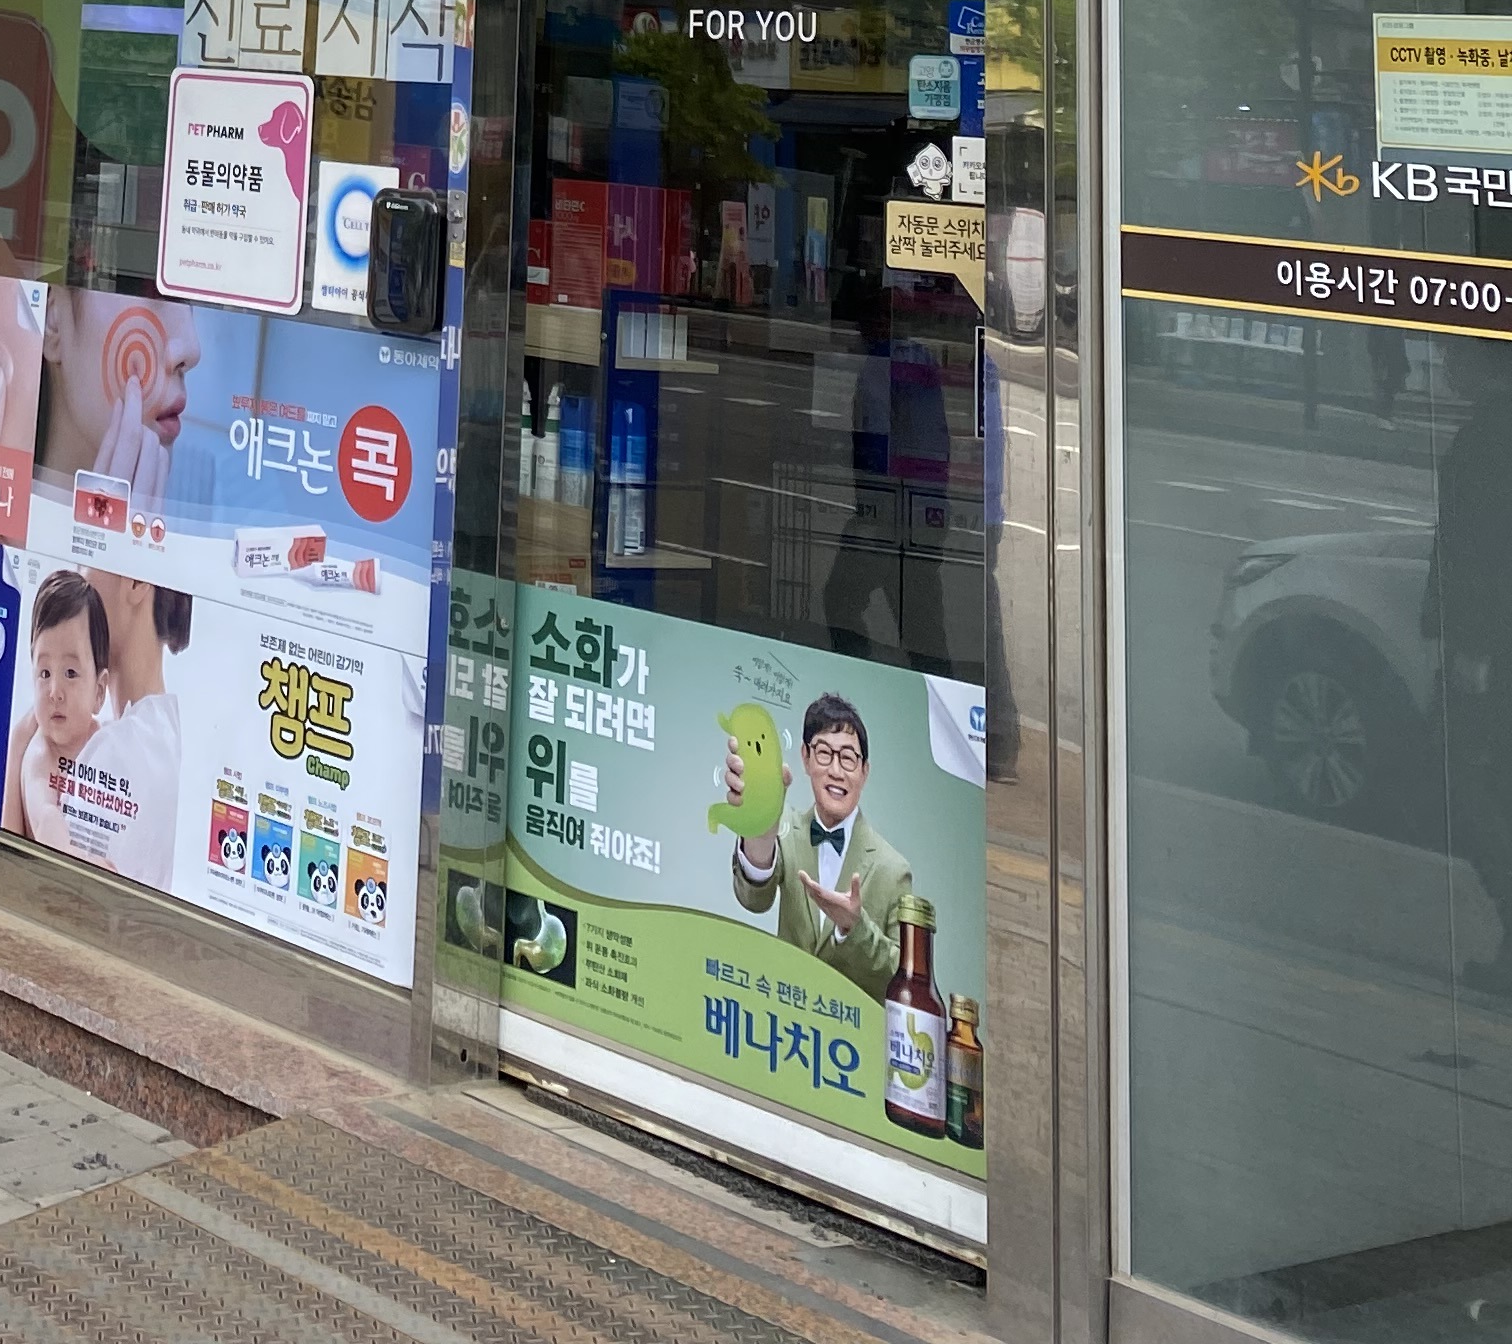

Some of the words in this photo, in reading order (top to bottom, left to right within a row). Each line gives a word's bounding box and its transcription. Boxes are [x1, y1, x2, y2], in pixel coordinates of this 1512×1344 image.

[688, 9, 745, 41] FOR
[756, 10, 818, 43] YOU
[1390, 46, 1422, 64] CCTV
[1424, 46, 1447, 66] 촬영
[1456, 48, 1496, 68] 녹화중,
[187, 122, 206, 139] PET
[206, 124, 245, 141] PHARM
[185, 159, 264, 193] 동물의약품
[231, 204, 247, 219] 약국
[897, 214, 940, 236] 자동문
[944, 217, 985, 240] 스위치
[889, 234, 917, 255] 살짝
[919, 238, 985, 262] 눌러주세요
[1277, 259, 1399, 306] 이용시간
[393, 349, 439, 372] 동아제약
[228, 415, 335, 496] 애크논
[351, 426, 400, 503] 콕
[260, 633, 287, 655] 보존제
[287, 641, 307, 662] 없는
[306, 645, 336, 669] 어린이
[335, 653, 365, 676] 감기약
[528, 609, 651, 696] 소화가
[258, 656, 355, 761] 챔프
[527, 675, 558, 726] 잘
[564, 680, 657, 754] 되려면
[58, 756, 76, 777] 우리
[78, 763, 96, 785] 아이
[98, 770, 117, 792] 먹는
[119, 777, 132, 798] 약,
[306, 754, 351, 791] Champ
[525, 731, 600, 814] 위를
[48, 772, 76, 797] 보존제
[78, 782, 139, 821] 확인하셨어요?
[525, 802, 586, 852] 움직여
[589, 820, 662, 876] 줘야죠!
[705, 956, 751, 992] 빠르고
[755, 969, 774, 997] 속
[776, 973, 809, 1008] 편한
[812, 985, 862, 1031] 소화제
[703, 992, 868, 1100] 베나치오
[888, 1038, 936, 1070] 베나치오
